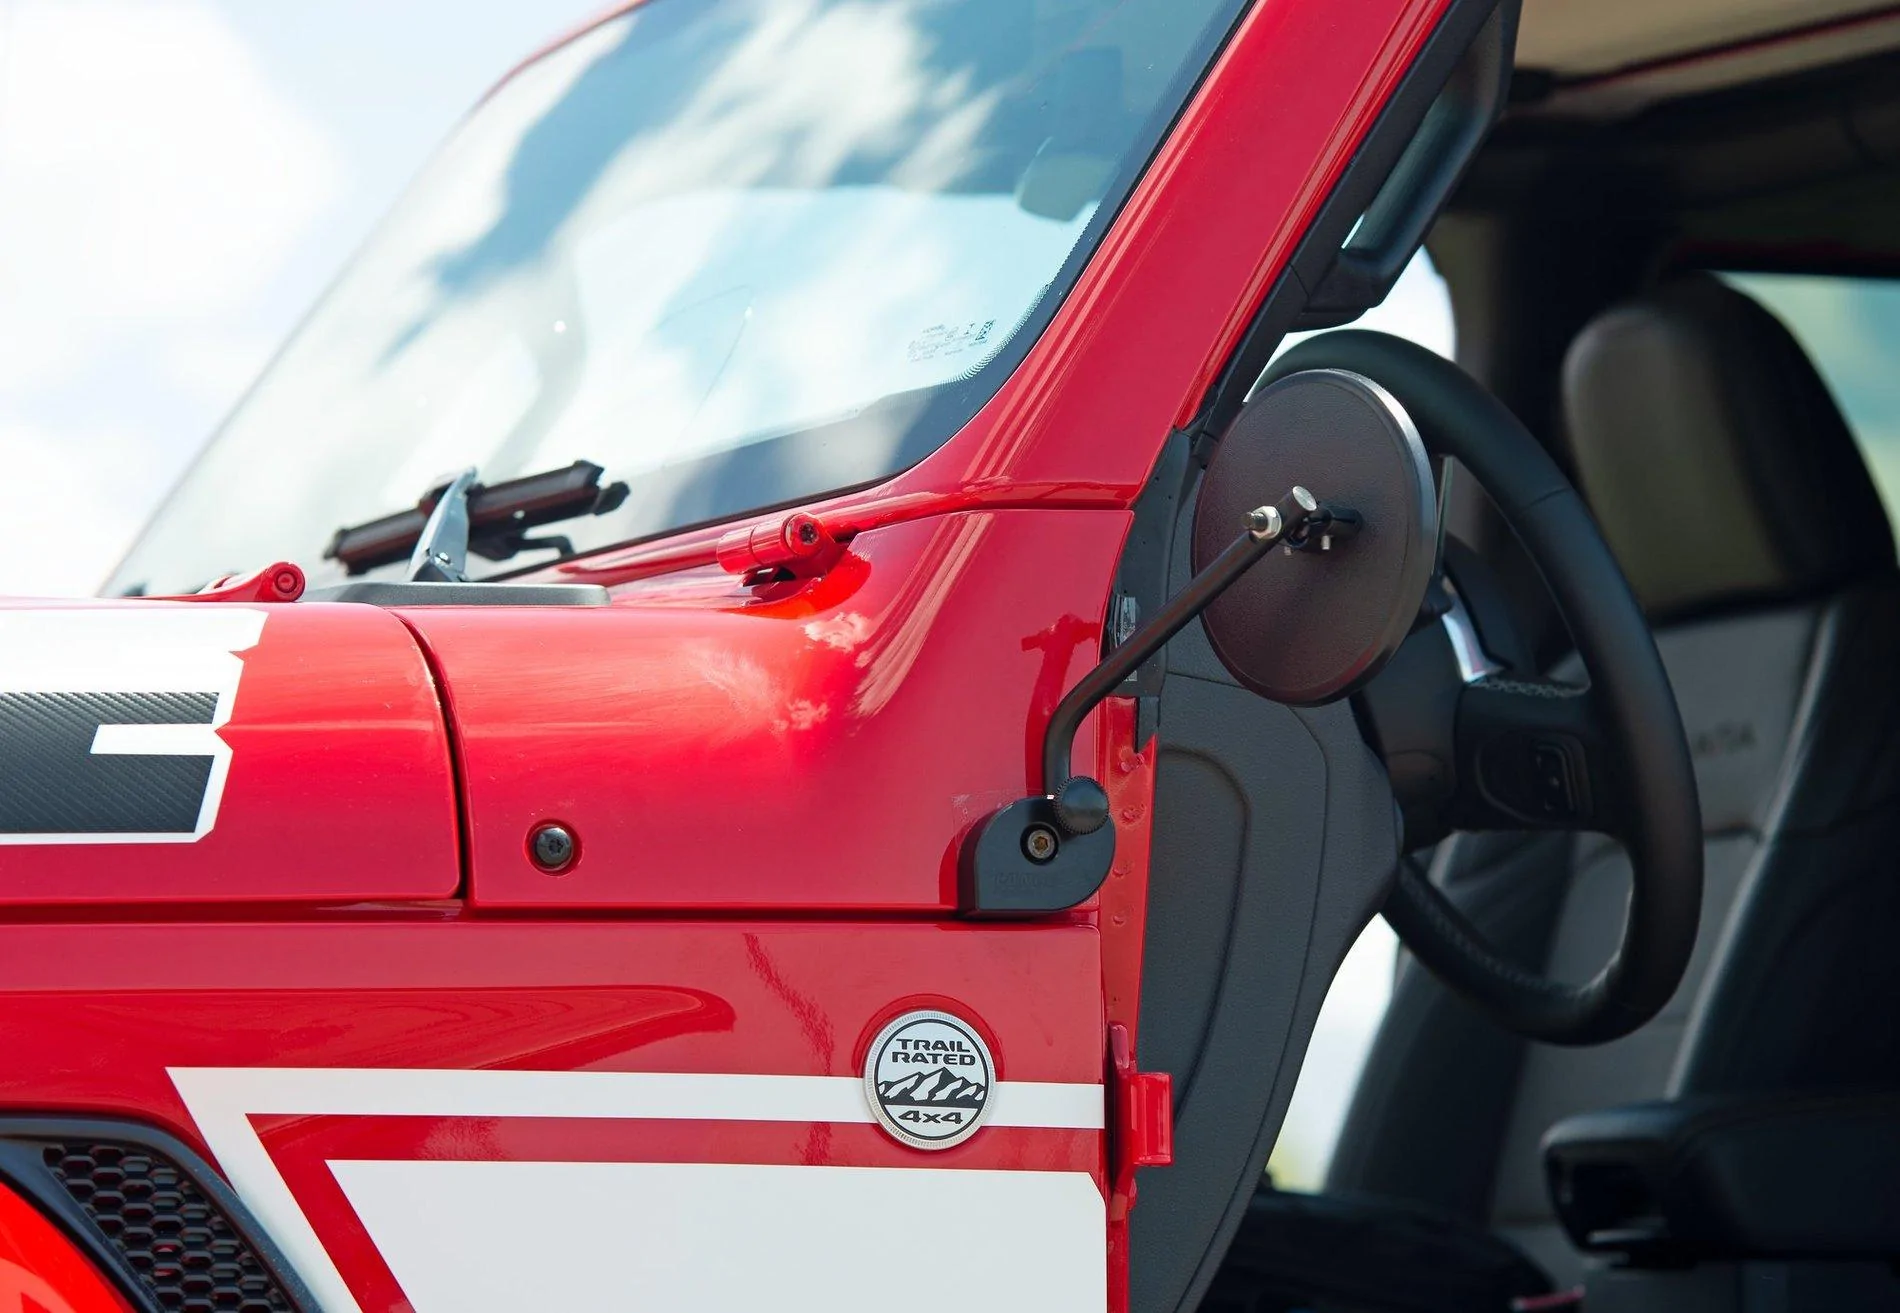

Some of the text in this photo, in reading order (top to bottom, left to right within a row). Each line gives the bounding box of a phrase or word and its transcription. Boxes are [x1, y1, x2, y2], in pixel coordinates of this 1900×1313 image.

[896, 1038, 971, 1053] TRAIL
[891, 1051, 976, 1066] RATED
[898, 1110, 963, 1125] 4x4
